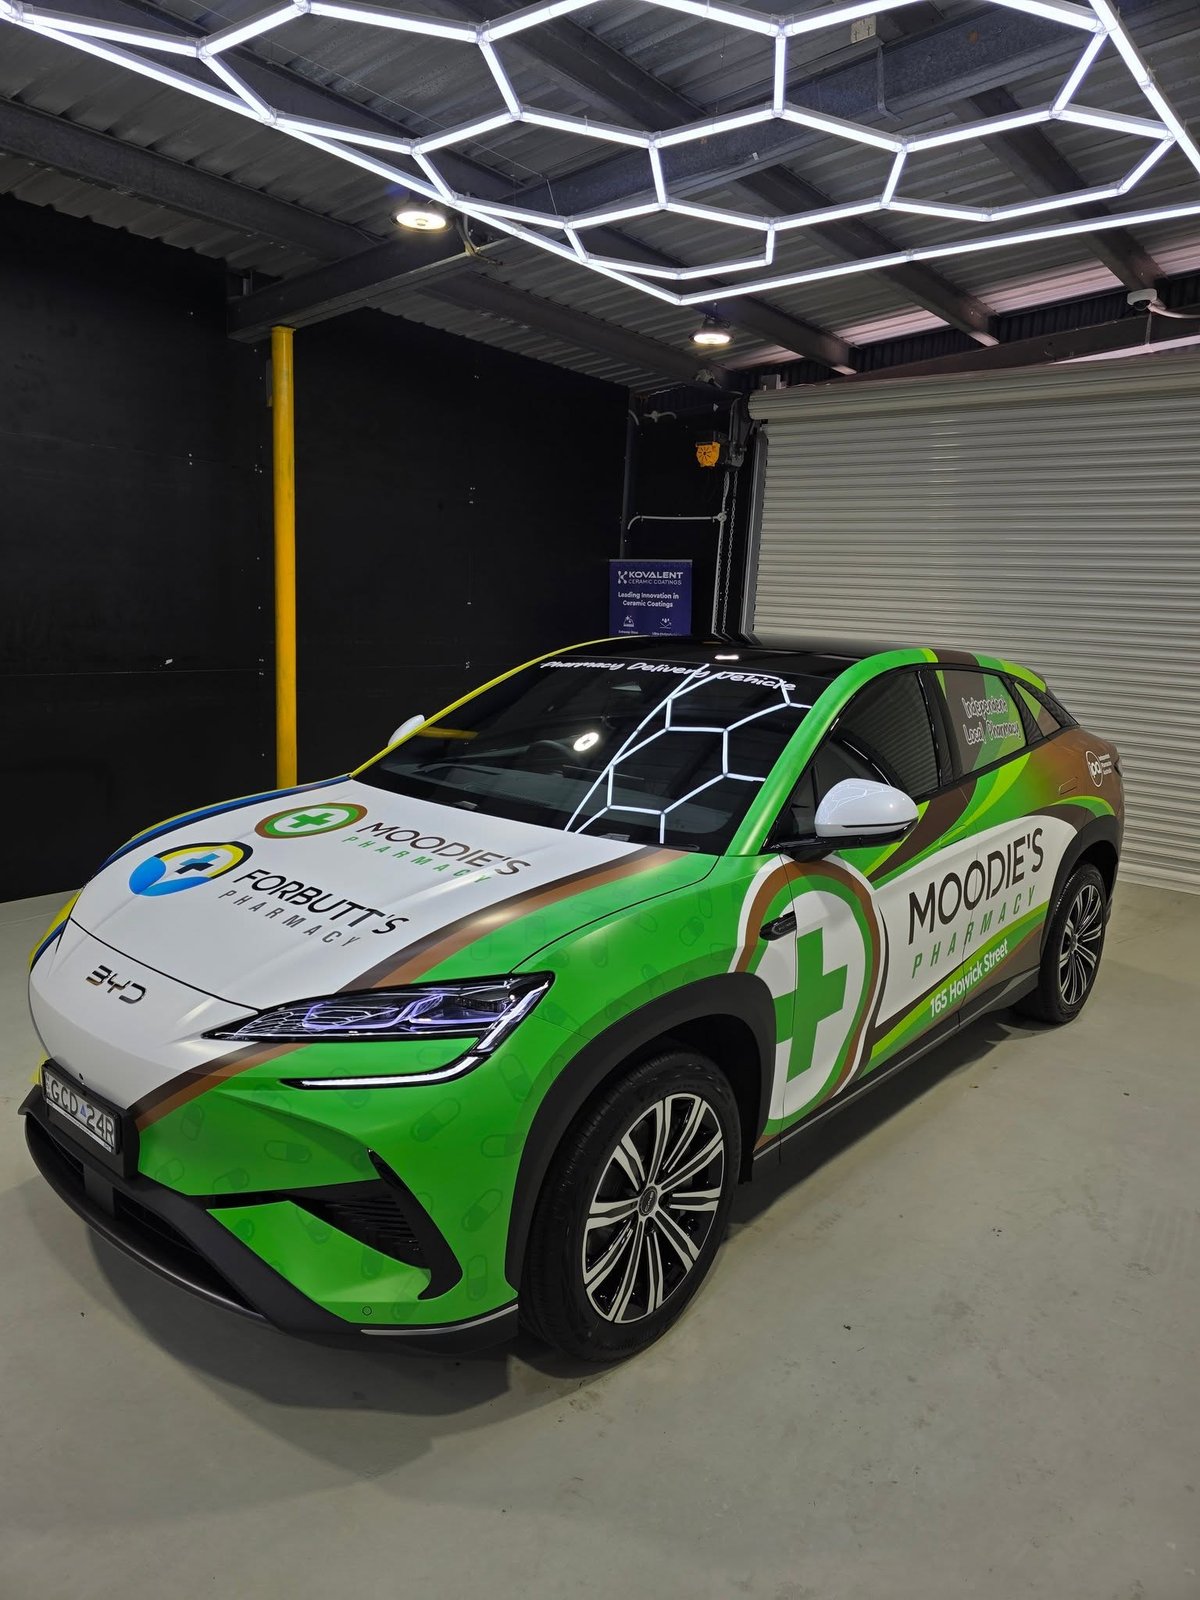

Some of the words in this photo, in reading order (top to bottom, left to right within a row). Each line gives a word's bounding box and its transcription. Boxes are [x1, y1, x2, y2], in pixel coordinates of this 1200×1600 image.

[617, 591, 641, 600] Leading
[641, 592, 672, 600] Innovation
[672, 592, 680, 600] in
[628, 571, 684, 579] KOVALENT
[646, 600, 674, 609] Coatings
[540, 660, 625, 671] Pharmacy
[626, 661, 710, 678] Delivery
[714, 670, 797, 692] Vehicle
[961, 694, 1009, 720] Independent
[962, 721, 987, 746] Local
[341, 835, 492, 884] PHARMACY
[354, 820, 532, 877] MOODIE'S
[232, 868, 410, 936] FORBUTT'S
[907, 827, 1044, 946] MOODIE'S
[217, 889, 361, 948] PHARMACY
[911, 885, 1036, 980] PHARMACY
[85, 964, 147, 1004] BYD
[929, 989, 948, 1018] 165
[948, 963, 983, 1004] Howick
[982, 938, 1009, 972] Street
